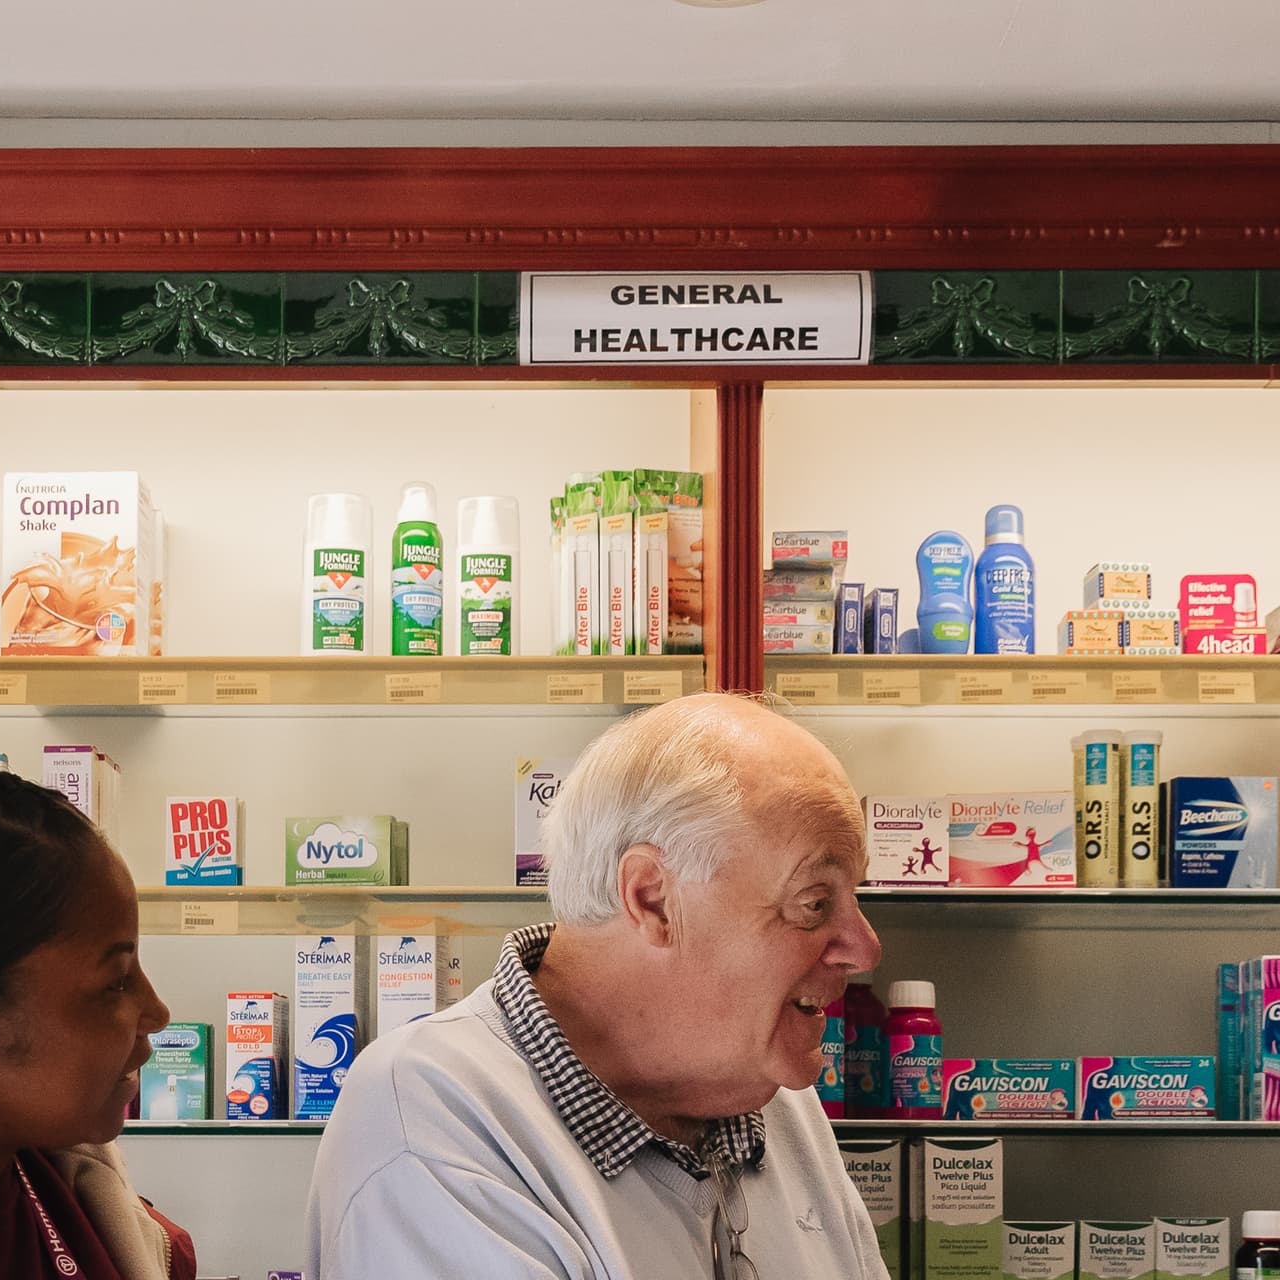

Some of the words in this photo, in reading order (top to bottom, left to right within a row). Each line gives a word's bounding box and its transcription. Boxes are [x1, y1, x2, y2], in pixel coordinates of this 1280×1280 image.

[611, 285, 783, 305] GENERAL
[574, 327, 818, 353] HEALTHCARE
[20, 485, 66, 494] NUTRICIA
[20, 494, 120, 521] Complan
[20, 519, 57, 531] Shake
[774, 536, 820, 547] Clearblue
[320, 552, 360, 567] JUNGLE
[404, 544, 440, 560] JUNGLE
[466, 557, 506, 573] JUNGLE
[1188, 583, 1227, 593] Effective
[577, 586, 588, 611] Bite
[611, 586, 622, 611] Bite
[648, 585, 659, 610] Bite
[1188, 594, 1231, 604] headache
[1189, 606, 1214, 617] relief
[577, 614, 588, 647] After
[611, 614, 622, 647] After
[648, 614, 659, 647] After
[1198, 636, 1255, 654] 4head
[170, 799, 227, 833] PRO
[873, 800, 943, 820] Dioralyte
[951, 800, 1020, 818] Dioralyte
[1023, 799, 1064, 815] Relief
[1181, 809, 1245, 826] Beechams
[1085, 799, 1103, 860] O.R.S
[1131, 800, 1150, 861] O.R.S
[174, 829, 231, 860] PLUS
[306, 838, 364, 863] Nytol
[295, 869, 325, 880] Herbal
[379, 973, 433, 981] CONGESTION
[954, 1075, 1048, 1092] GAVISCON
[1092, 1074, 1188, 1090] GAVISCON
[998, 1092, 1048, 1101] DOUBLE
[1136, 1090, 1188, 1099] DOUBLE
[933, 1156, 993, 1170] Dulcolax
[933, 1171, 969, 1181] Twelve
[972, 1171, 994, 1181] Plus
[941, 1182, 958, 1191] Pico
[961, 1182, 987, 1193] Liquid
[1008, 1232, 1065, 1245] Dulcolax
[1089, 1232, 1146, 1246] Dulcolax
[1163, 1232, 1220, 1244] Dulcolax
[1024, 1246, 1049, 1255] Adult
[1089, 1246, 1123, 1256] Twelve
[1126, 1246, 1146, 1256] Plus
[1163, 1245, 1197, 1254] Twelve
[1200, 1245, 1220, 1255] Plus
